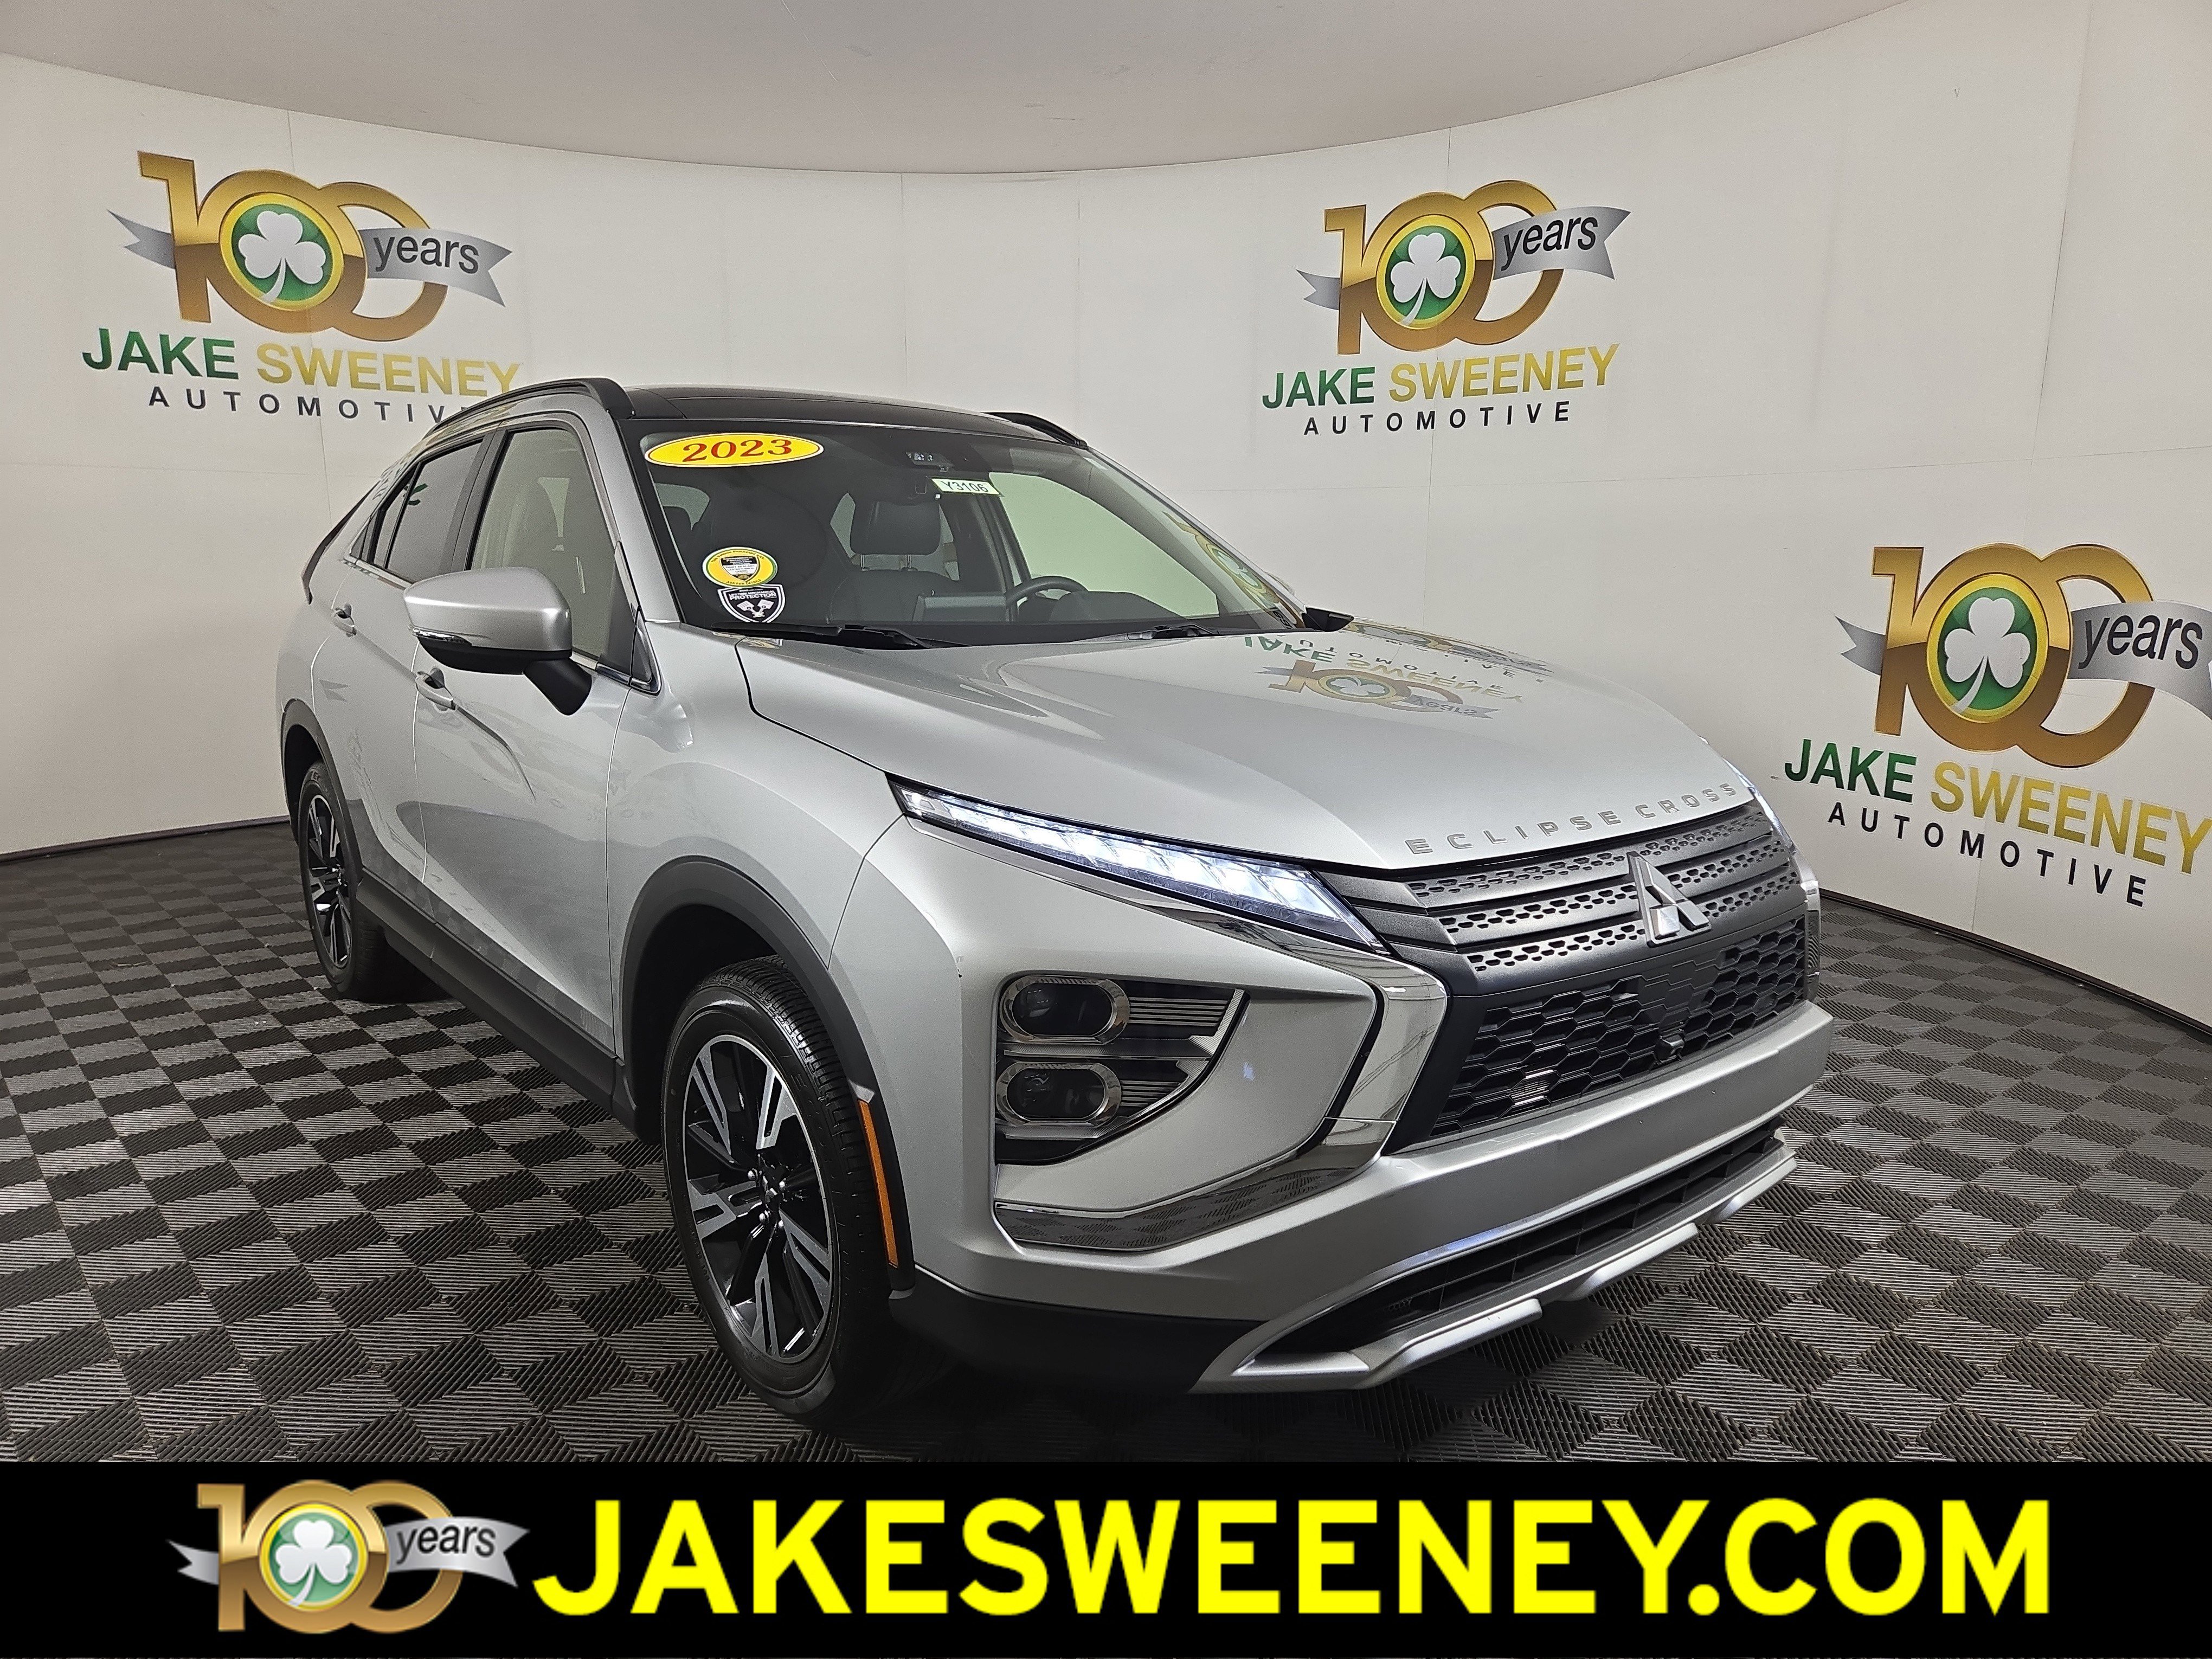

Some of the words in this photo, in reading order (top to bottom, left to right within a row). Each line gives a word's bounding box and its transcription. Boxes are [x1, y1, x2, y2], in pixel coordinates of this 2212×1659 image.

[137, 150, 449, 341] 100
[372, 235, 479, 274] years
[1324, 179, 1564, 356] 100
[1501, 216, 1598, 271] years
[82, 327, 239, 380] JAKE
[256, 343, 520, 396] SWEENEY
[1262, 366, 1375, 409] JAKE
[1389, 343, 1620, 402] SWEENEY
[149, 385, 469, 423] AUTOMOTIV
[1304, 401, 1570, 435] AUTOMOTIVE
[681, 439, 793, 462] 2023
[940, 480, 989, 492] Y3106
[730, 593, 777, 601] PROTECTION
[1872, 543, 2155, 768] 100
[2078, 615, 2203, 670] years
[1405, 810, 1622, 854] ECLIPSE
[1635, 783, 1737, 818] CROSS
[1785, 738, 1917, 803] JAKE
[1931, 761, 2212, 874] SWEENEY
[1828, 802, 2147, 908] AUTOMOTIVE
